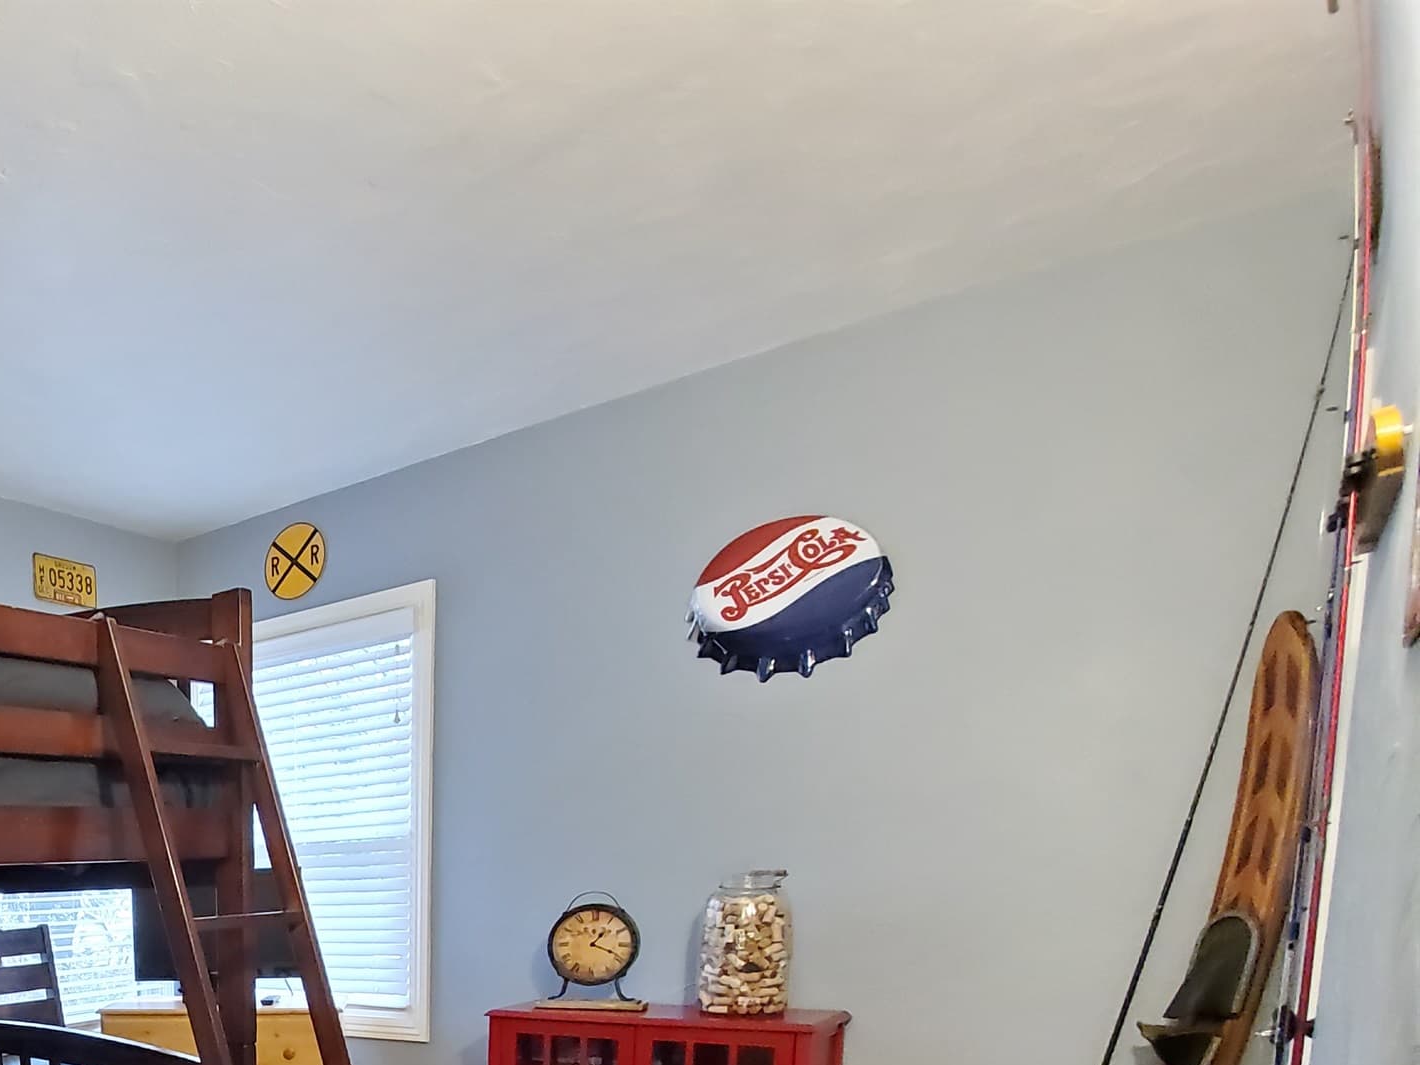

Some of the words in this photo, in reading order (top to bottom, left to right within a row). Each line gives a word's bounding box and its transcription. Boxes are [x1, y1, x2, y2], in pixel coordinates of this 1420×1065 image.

[271, 556, 280, 577] R
[309, 544, 320, 566] R
[49, 567, 93, 596] 05338
